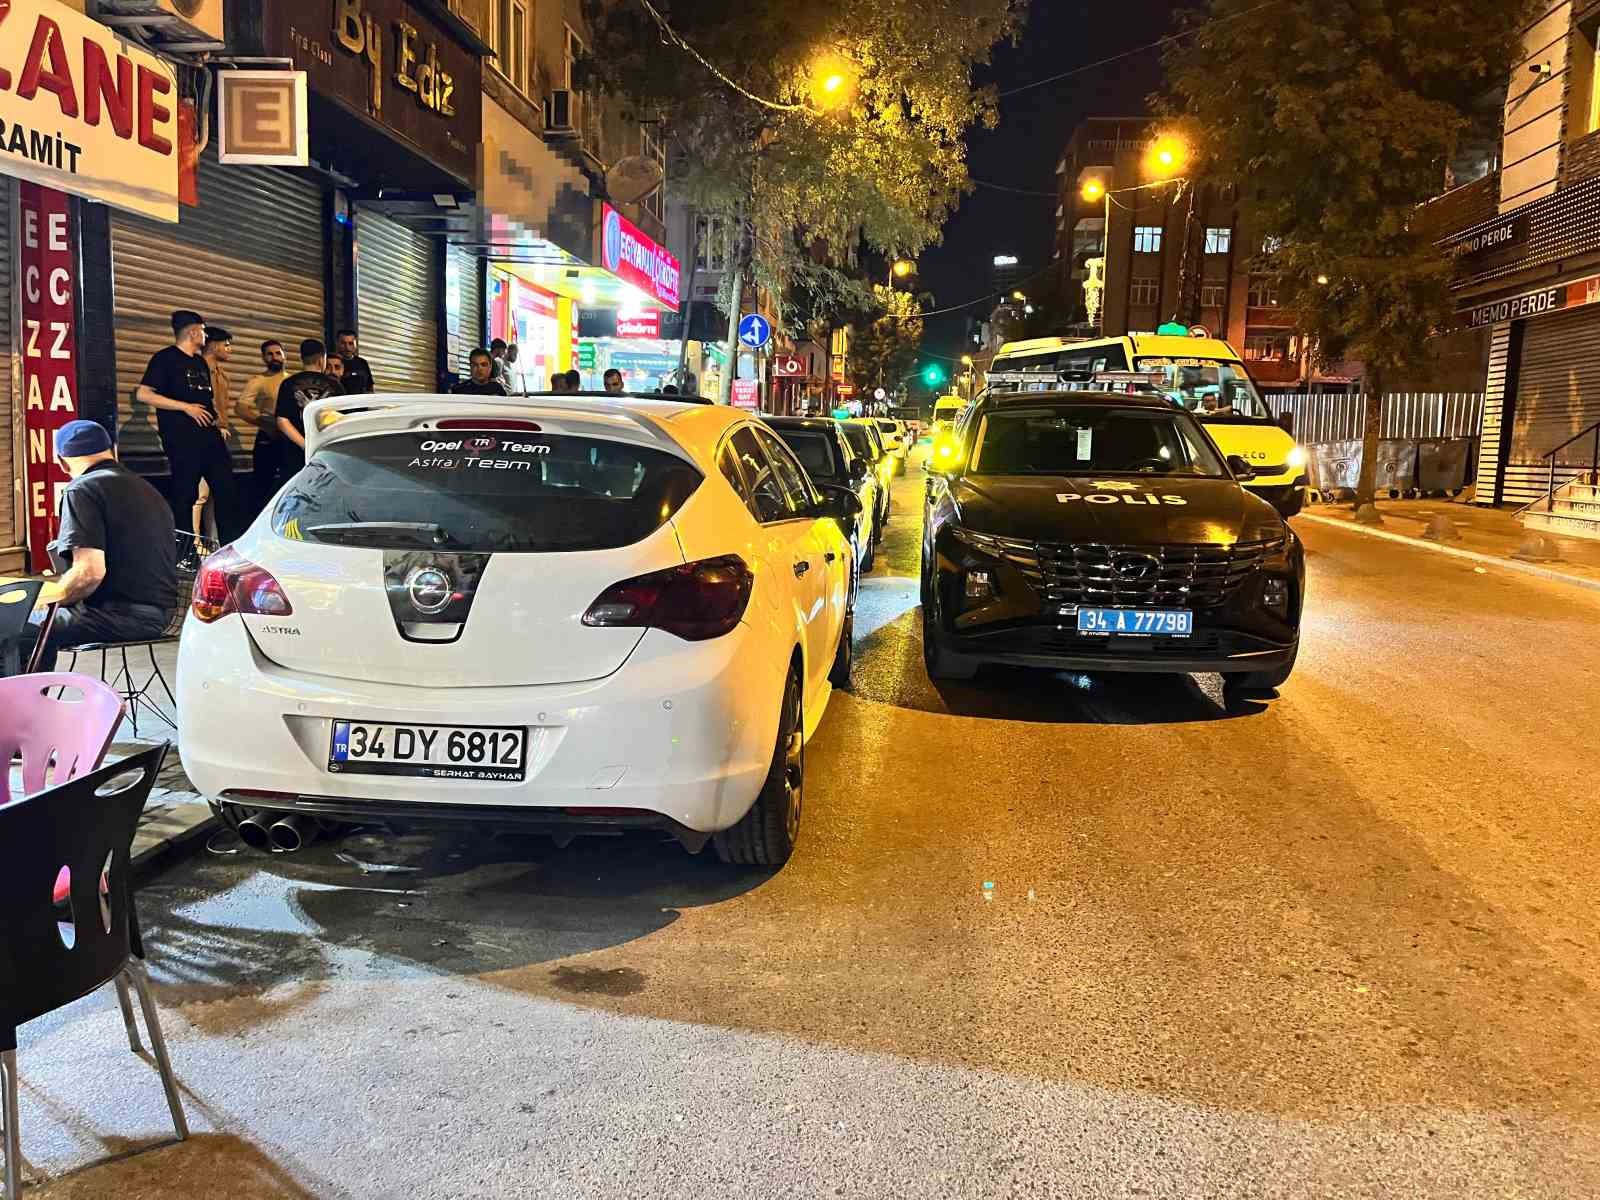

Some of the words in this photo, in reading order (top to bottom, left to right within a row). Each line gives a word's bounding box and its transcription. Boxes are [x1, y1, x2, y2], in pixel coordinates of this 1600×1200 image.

[0, 0, 173, 156] ANE
[241, 91, 281, 142] E
[1481, 224, 1513, 249] PERDE
[1471, 302, 1508, 327] MEMO
[1510, 289, 1557, 319] PERDE
[25, 209, 47, 517] ECZANE
[420, 440, 463, 453] Opel
[473, 438, 490, 446] TR
[501, 441, 551, 454] Team
[463, 457, 531, 470] Team
[1055, 493, 1188, 505] POLİS
[262, 624, 301, 636] ASTRA
[1086, 611, 1107, 629] 34
[1116, 611, 1126, 630] A
[1134, 613, 1188, 631] 77798
[336, 743, 347, 753] TR
[350, 726, 385, 758] 34
[394, 728, 439, 760] DY
[447, 731, 520, 764] 6812
[433, 769, 475, 778] SERHAT
